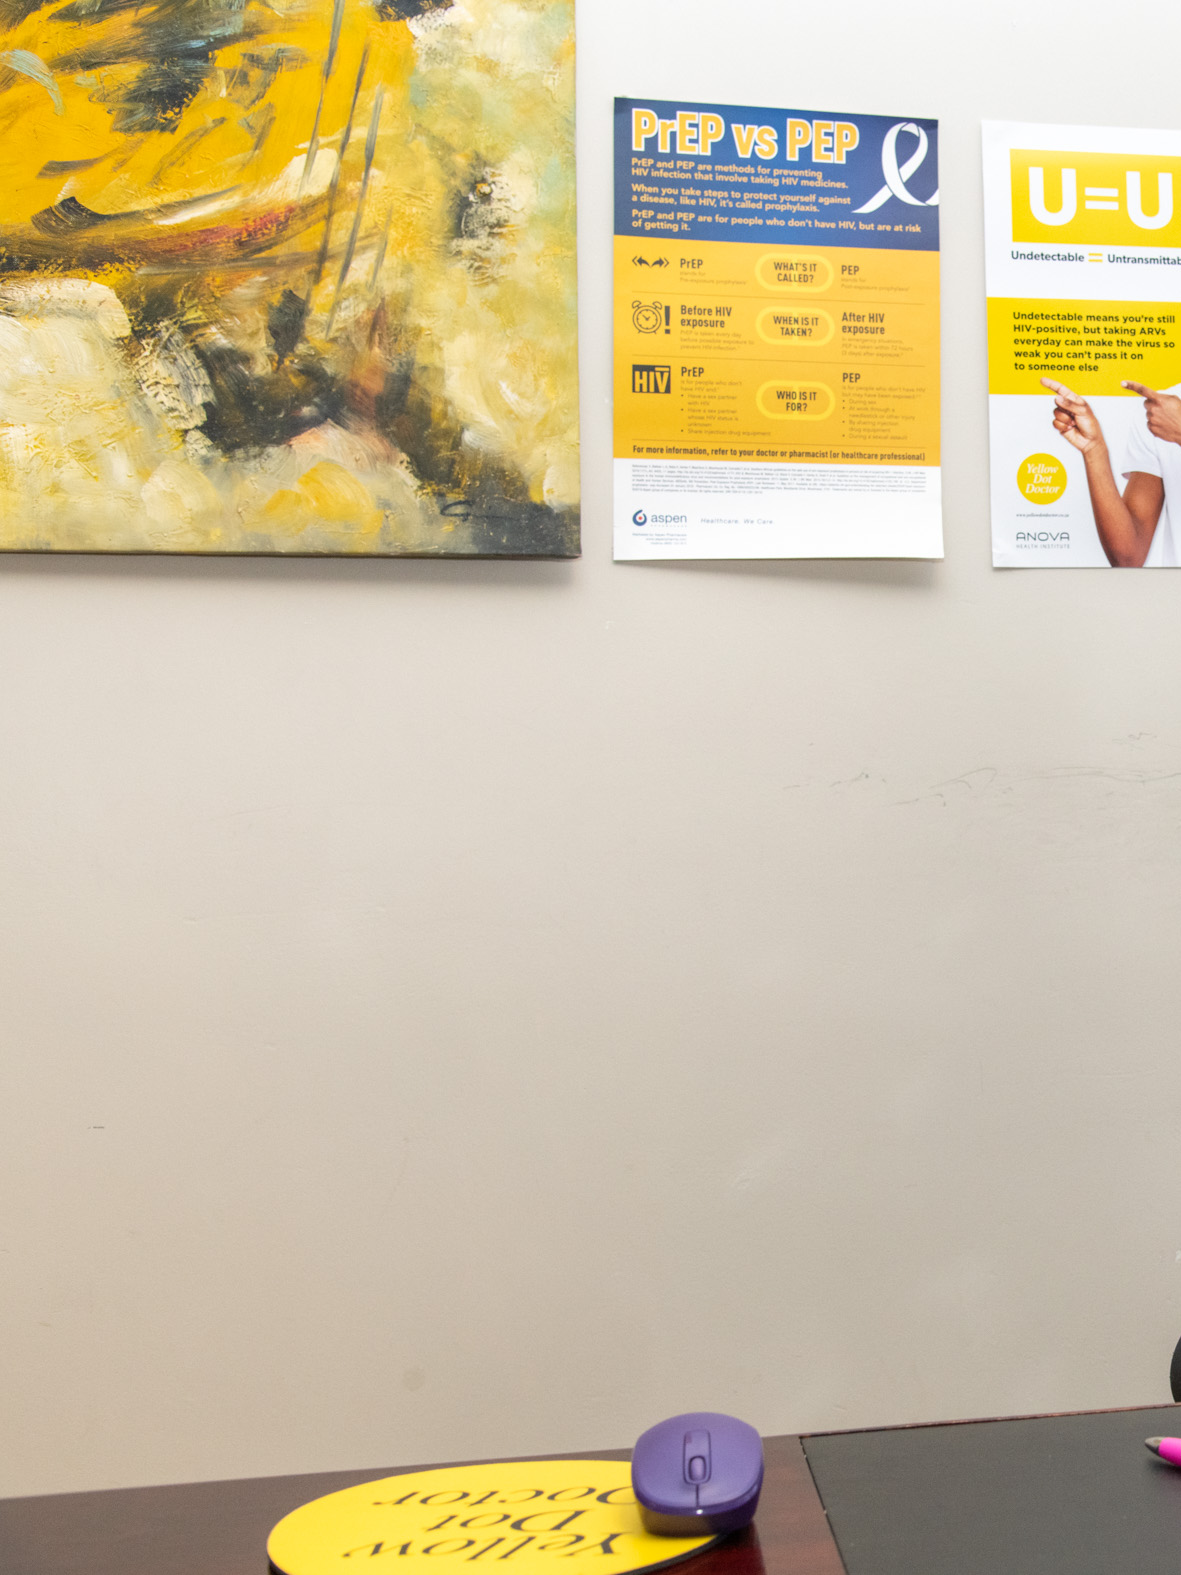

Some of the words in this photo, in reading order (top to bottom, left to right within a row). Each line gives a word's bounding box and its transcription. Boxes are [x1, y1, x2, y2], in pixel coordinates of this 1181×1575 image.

[632, 108, 725, 156] PrEP
[731, 124, 778, 160] vs
[786, 118, 859, 164] PEP
[631, 157, 654, 170] PrEP
[656, 160, 674, 171] and
[676, 160, 695, 172] PEP
[697, 164, 712, 173] are
[714, 164, 755, 175] methods
[757, 165, 771, 177] for
[773, 169, 823, 181] preventing
[631, 167, 649, 176] HIV
[651, 169, 692, 179] infection
[694, 171, 713, 181] that
[715, 173, 748, 183] involve
[750, 175, 779, 187] taking
[782, 177, 799, 185] HIV
[801, 178, 848, 189] medicines.
[631, 183, 659, 196] When
[661, 188, 678, 196] you
[680, 187, 702, 200] take
[703, 189, 729, 201] steps
[743, 192, 777, 203] protect
[779, 194, 816, 206] yourself
[818, 195, 851, 205] against
[1028, 166, 1174, 230] U=U
[640, 194, 677, 205] disease,
[680, 196, 696, 205] like
[699, 198, 717, 207] HIV,
[718, 198, 733, 208] it's
[735, 199, 762, 209] called
[765, 201, 820, 213] prophylaxis.
[632, 209, 654, 221] PrEP
[656, 212, 674, 222] and
[677, 212, 695, 221] PEP
[715, 214, 729, 223] for
[731, 216, 763, 226] people
[765, 217, 785, 226] who
[787, 218, 812, 227] don't
[814, 219, 836, 228] have
[838, 221, 856, 230] HIV,
[859, 221, 875, 230] but
[893, 224, 903, 232] at
[905, 224, 921, 232] risk
[632, 219, 642, 227] of
[644, 221, 679, 232] getting
[681, 222, 690, 231] it.
[1011, 251, 1085, 262] Undetectable
[680, 258, 703, 269] PrEP
[773, 262, 808, 272] WHAT'S
[809, 263, 817, 272] IT
[841, 265, 860, 275] PEP
[777, 273, 814, 283] CALLED?
[681, 305, 713, 316] Before
[715, 306, 732, 317] HIV
[680, 318, 725, 328] exposure
[773, 316, 799, 325] WHEN
[801, 317, 809, 326] IS
[811, 317, 819, 326] IT
[842, 312, 866, 322] After
[868, 313, 885, 323] HIV
[1013, 312, 1083, 321] Undetectable
[1122, 315, 1154, 324] you're
[1157, 315, 1175, 323] still
[780, 327, 812, 336] TAKEN?
[842, 325, 885, 335] exposure
[1013, 324, 1080, 334] HIV-positive,
[1083, 326, 1101, 334] but
[1104, 326, 1136, 336] taking
[1139, 327, 1166, 335] ARVs
[1014, 337, 1061, 347] everyday
[1086, 339, 1113, 347] make
[1116, 339, 1133, 347] the
[1136, 340, 1161, 348] virus
[1014, 350, 1041, 358] weak
[1044, 352, 1063, 360] you
[1066, 351, 1091, 359] can't
[1120, 351, 1127, 360] it
[681, 366, 704, 377] PrEP
[1014, 362, 1025, 370] to
[1078, 363, 1099, 372] else
[634, 371, 670, 393] HIV
[842, 372, 861, 383] PEP
[776, 391, 797, 400] WHO
[799, 391, 807, 401] IS
[809, 392, 817, 401] IT
[786, 402, 808, 412] FOR?
[633, 445, 644, 453] For
[666, 446, 709, 456] information,
[730, 448, 737, 456] to
[756, 449, 778, 457] doctor
[789, 450, 828, 458] pharmacist
[830, 450, 840, 459] (or
[841, 451, 878, 459] healthcare
[880, 452, 925, 461] professional)
[1027, 463, 1059, 474] Yellow
[1033, 474, 1052, 484] Dot
[1025, 483, 1060, 494] Doctor
[651, 514, 687, 524] aspen
[1016, 532, 1070, 542] ANOVA
[425, 1509, 591, 1532] Dot
[342, 1532, 628, 1561] Yellow
